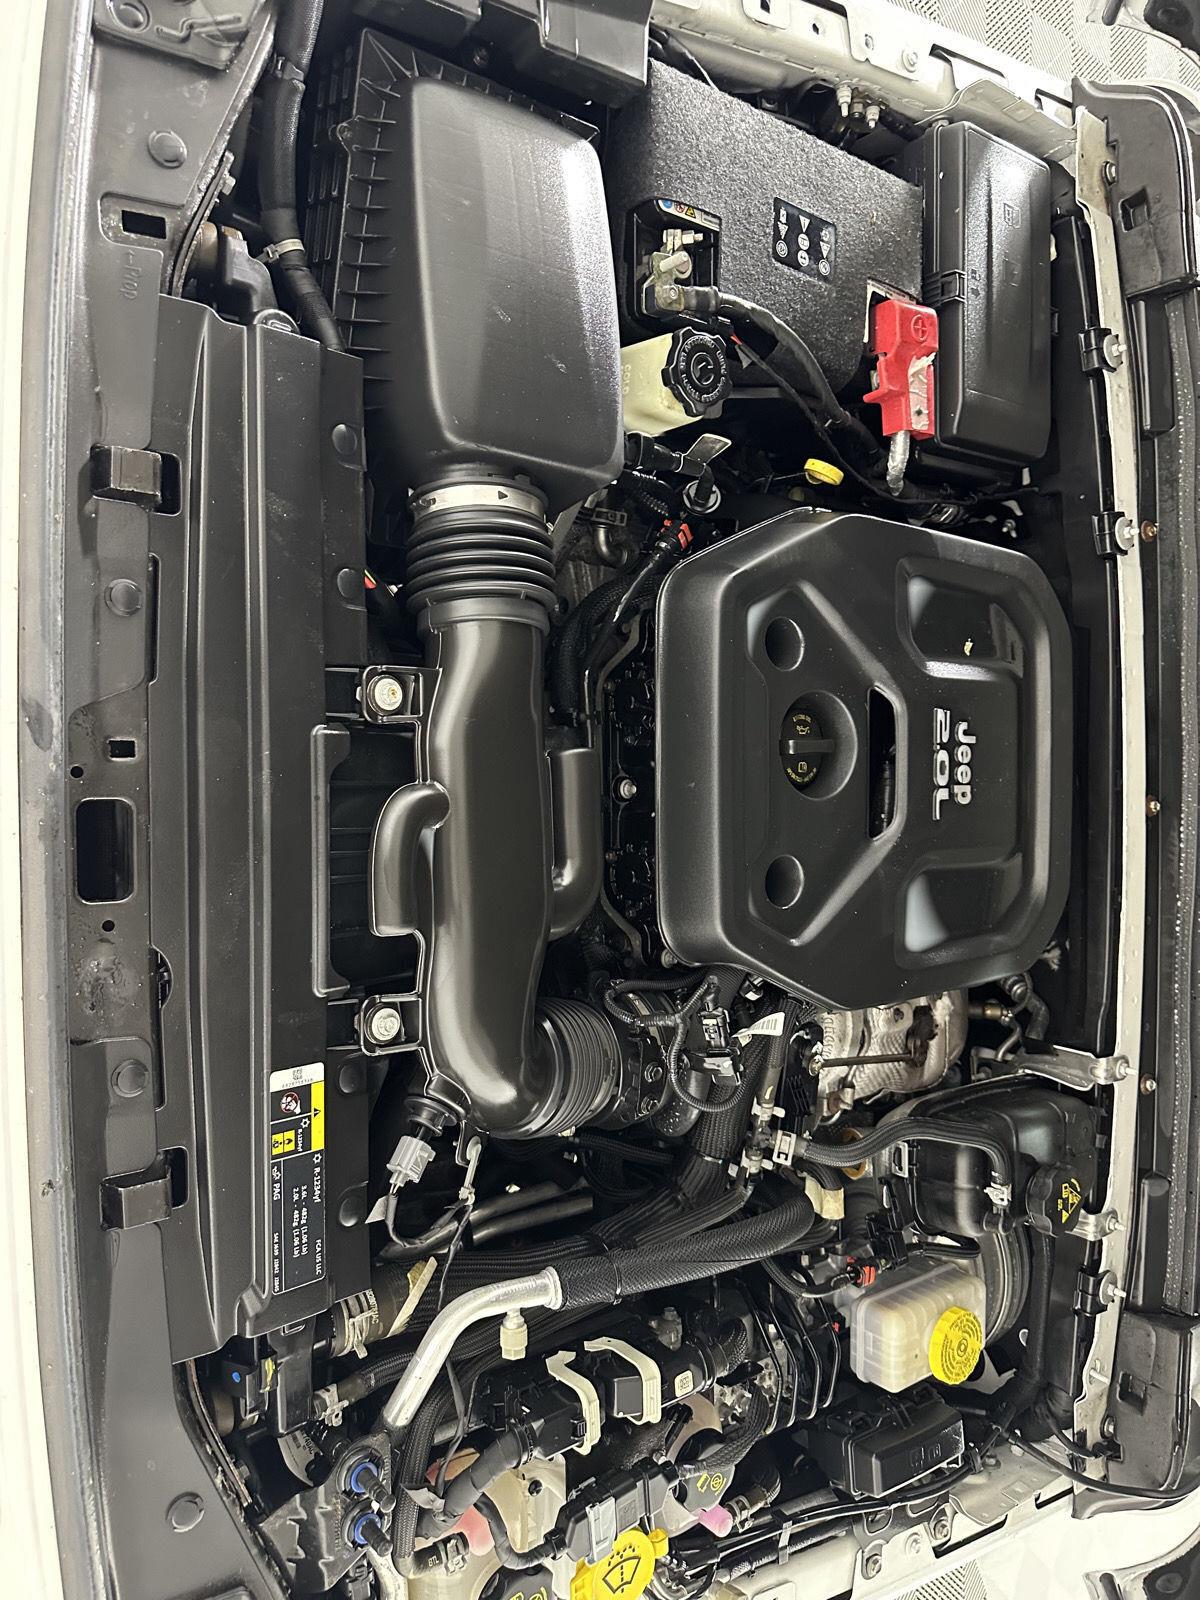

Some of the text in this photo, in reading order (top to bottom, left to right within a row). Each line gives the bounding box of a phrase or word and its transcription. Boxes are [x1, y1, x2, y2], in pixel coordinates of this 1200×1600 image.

[932, 708, 951, 821] 2.0L
[951, 721, 977, 805] Jeep
[273, 1183, 281, 1201] PAG
[312, 1166, 322, 1203] R-1234yf
[300, 1207, 308, 1224] 482g
[292, 1229, 300, 1246] (1.06
[300, 1226, 308, 1243] (1.06
[315, 1253, 321, 1262] US
